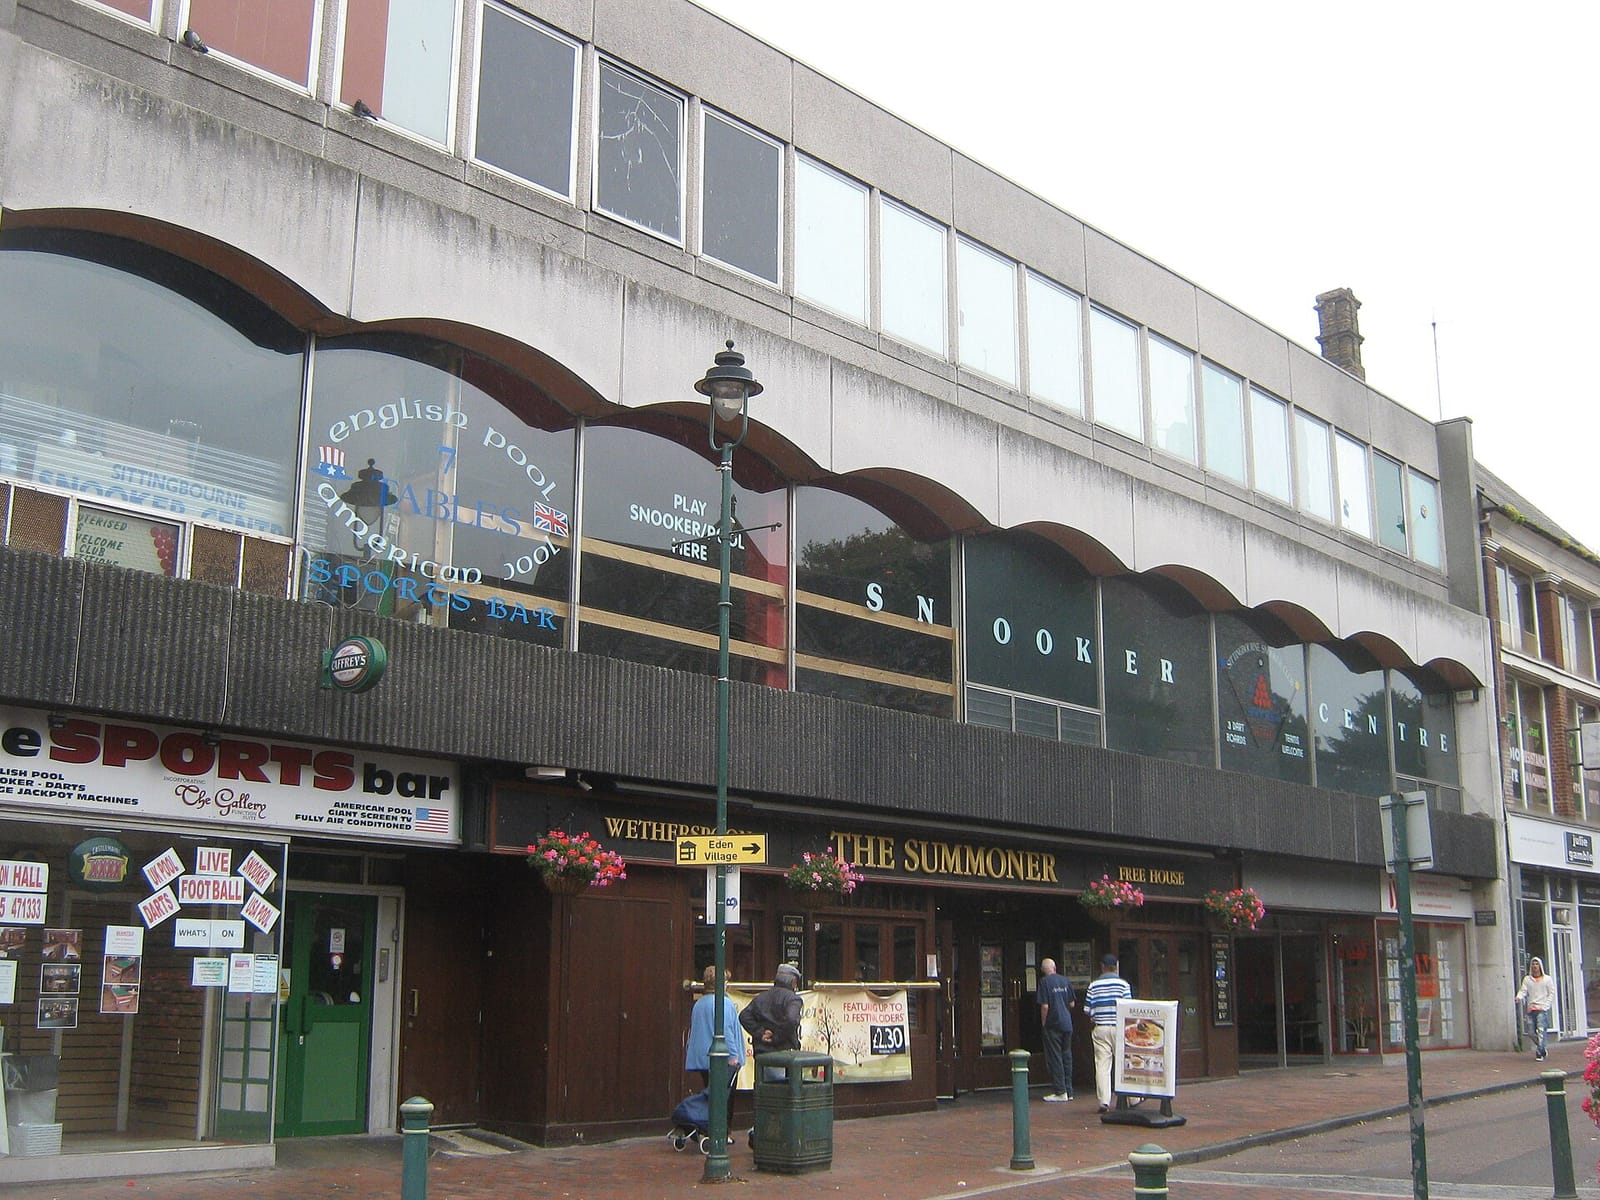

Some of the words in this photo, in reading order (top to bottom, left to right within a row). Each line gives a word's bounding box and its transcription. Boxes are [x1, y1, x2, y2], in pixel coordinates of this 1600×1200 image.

[438, 445, 456, 475] 7
[110, 463, 248, 511] SITTINGBOURNE
[370, 474, 521, 537] TABLES
[673, 493, 708, 517] PLAY
[629, 503, 746, 550] SNOOKER/POL
[79, 543, 106, 557] CLUB
[310, 558, 471, 611] SPORTS
[485, 596, 557, 630] BAR
[31, 770, 65, 781] POOL
[45, 781, 86, 792] DARTS
[363, 763, 449, 801] bar
[17, 787, 73, 800] JACKPOT
[77, 793, 139, 806] MACHINES
[174, 784, 212, 810] The
[214, 788, 267, 820] Gallery
[328, 809, 358, 818] GIANT
[360, 812, 398, 822] SCREEN
[333, 801, 385, 812] AMERICAN
[387, 807, 413, 815] POOL
[294, 813, 325, 822] FULLY
[327, 816, 344, 824] AIR
[346, 819, 412, 831] CONDITIONED
[708, 840, 734, 849] Eden
[199, 850, 230, 873] LIVE
[704, 851, 738, 862] Village
[829, 830, 896, 870] THE
[903, 839, 1059, 883] SUMMONER
[13, 865, 43, 889] HALL
[1118, 866, 1146, 883] FREE
[1149, 868, 1185, 886] HOUSE
[181, 879, 242, 901] FOOTBALL
[11, 897, 42, 920] 471333
[142, 892, 174, 924] DARTS
[178, 929, 207, 937] WHAT'S
[221, 929, 235, 938] ON
[843, 1013, 850, 1023] 12
[879, 1003, 888, 1012] UP
[888, 1002, 903, 1012] TO
[1129, 1007, 1161, 1016] BREAKFAST
[872, 1026, 903, 1049] £2.30
